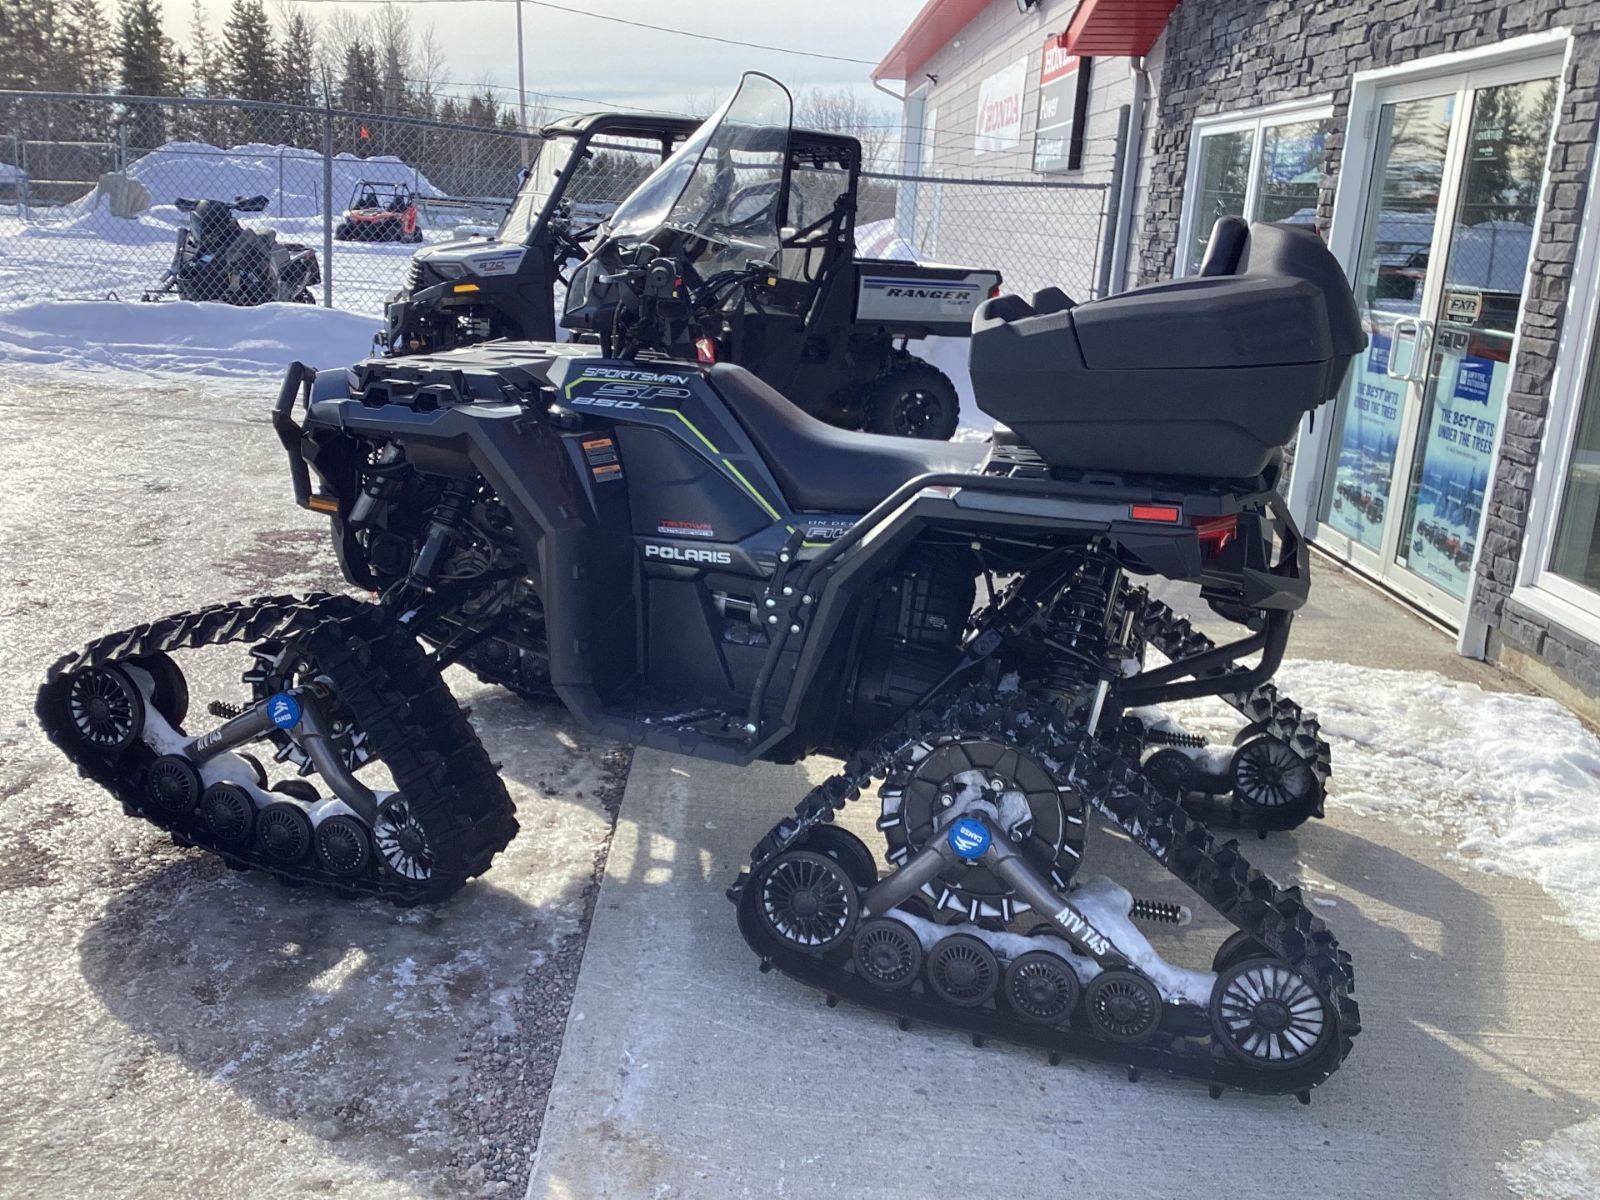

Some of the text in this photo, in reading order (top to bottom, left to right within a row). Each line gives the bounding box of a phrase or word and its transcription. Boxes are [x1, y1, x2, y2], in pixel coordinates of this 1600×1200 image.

[1044, 46, 1076, 75] HOND
[985, 95, 1019, 132] HONDA
[886, 288, 971, 300] RANGER
[1451, 299, 1477, 311] FXR
[582, 367, 689, 385] SPORTSMAN
[592, 382, 691, 400] SP
[1366, 384, 1385, 400] BEST
[571, 396, 640, 410] 850
[1381, 404, 1397, 420] TREES
[1441, 408, 1495, 437] THE BEST GIFTS
[1438, 424, 1458, 443] UNDER
[1459, 431, 1471, 448] THE
[1472, 435, 1493, 455] TREES
[645, 545, 731, 564] POLARIS
[959, 826, 983, 844] CAMSO
[1055, 907, 1111, 956] ATV T4S
